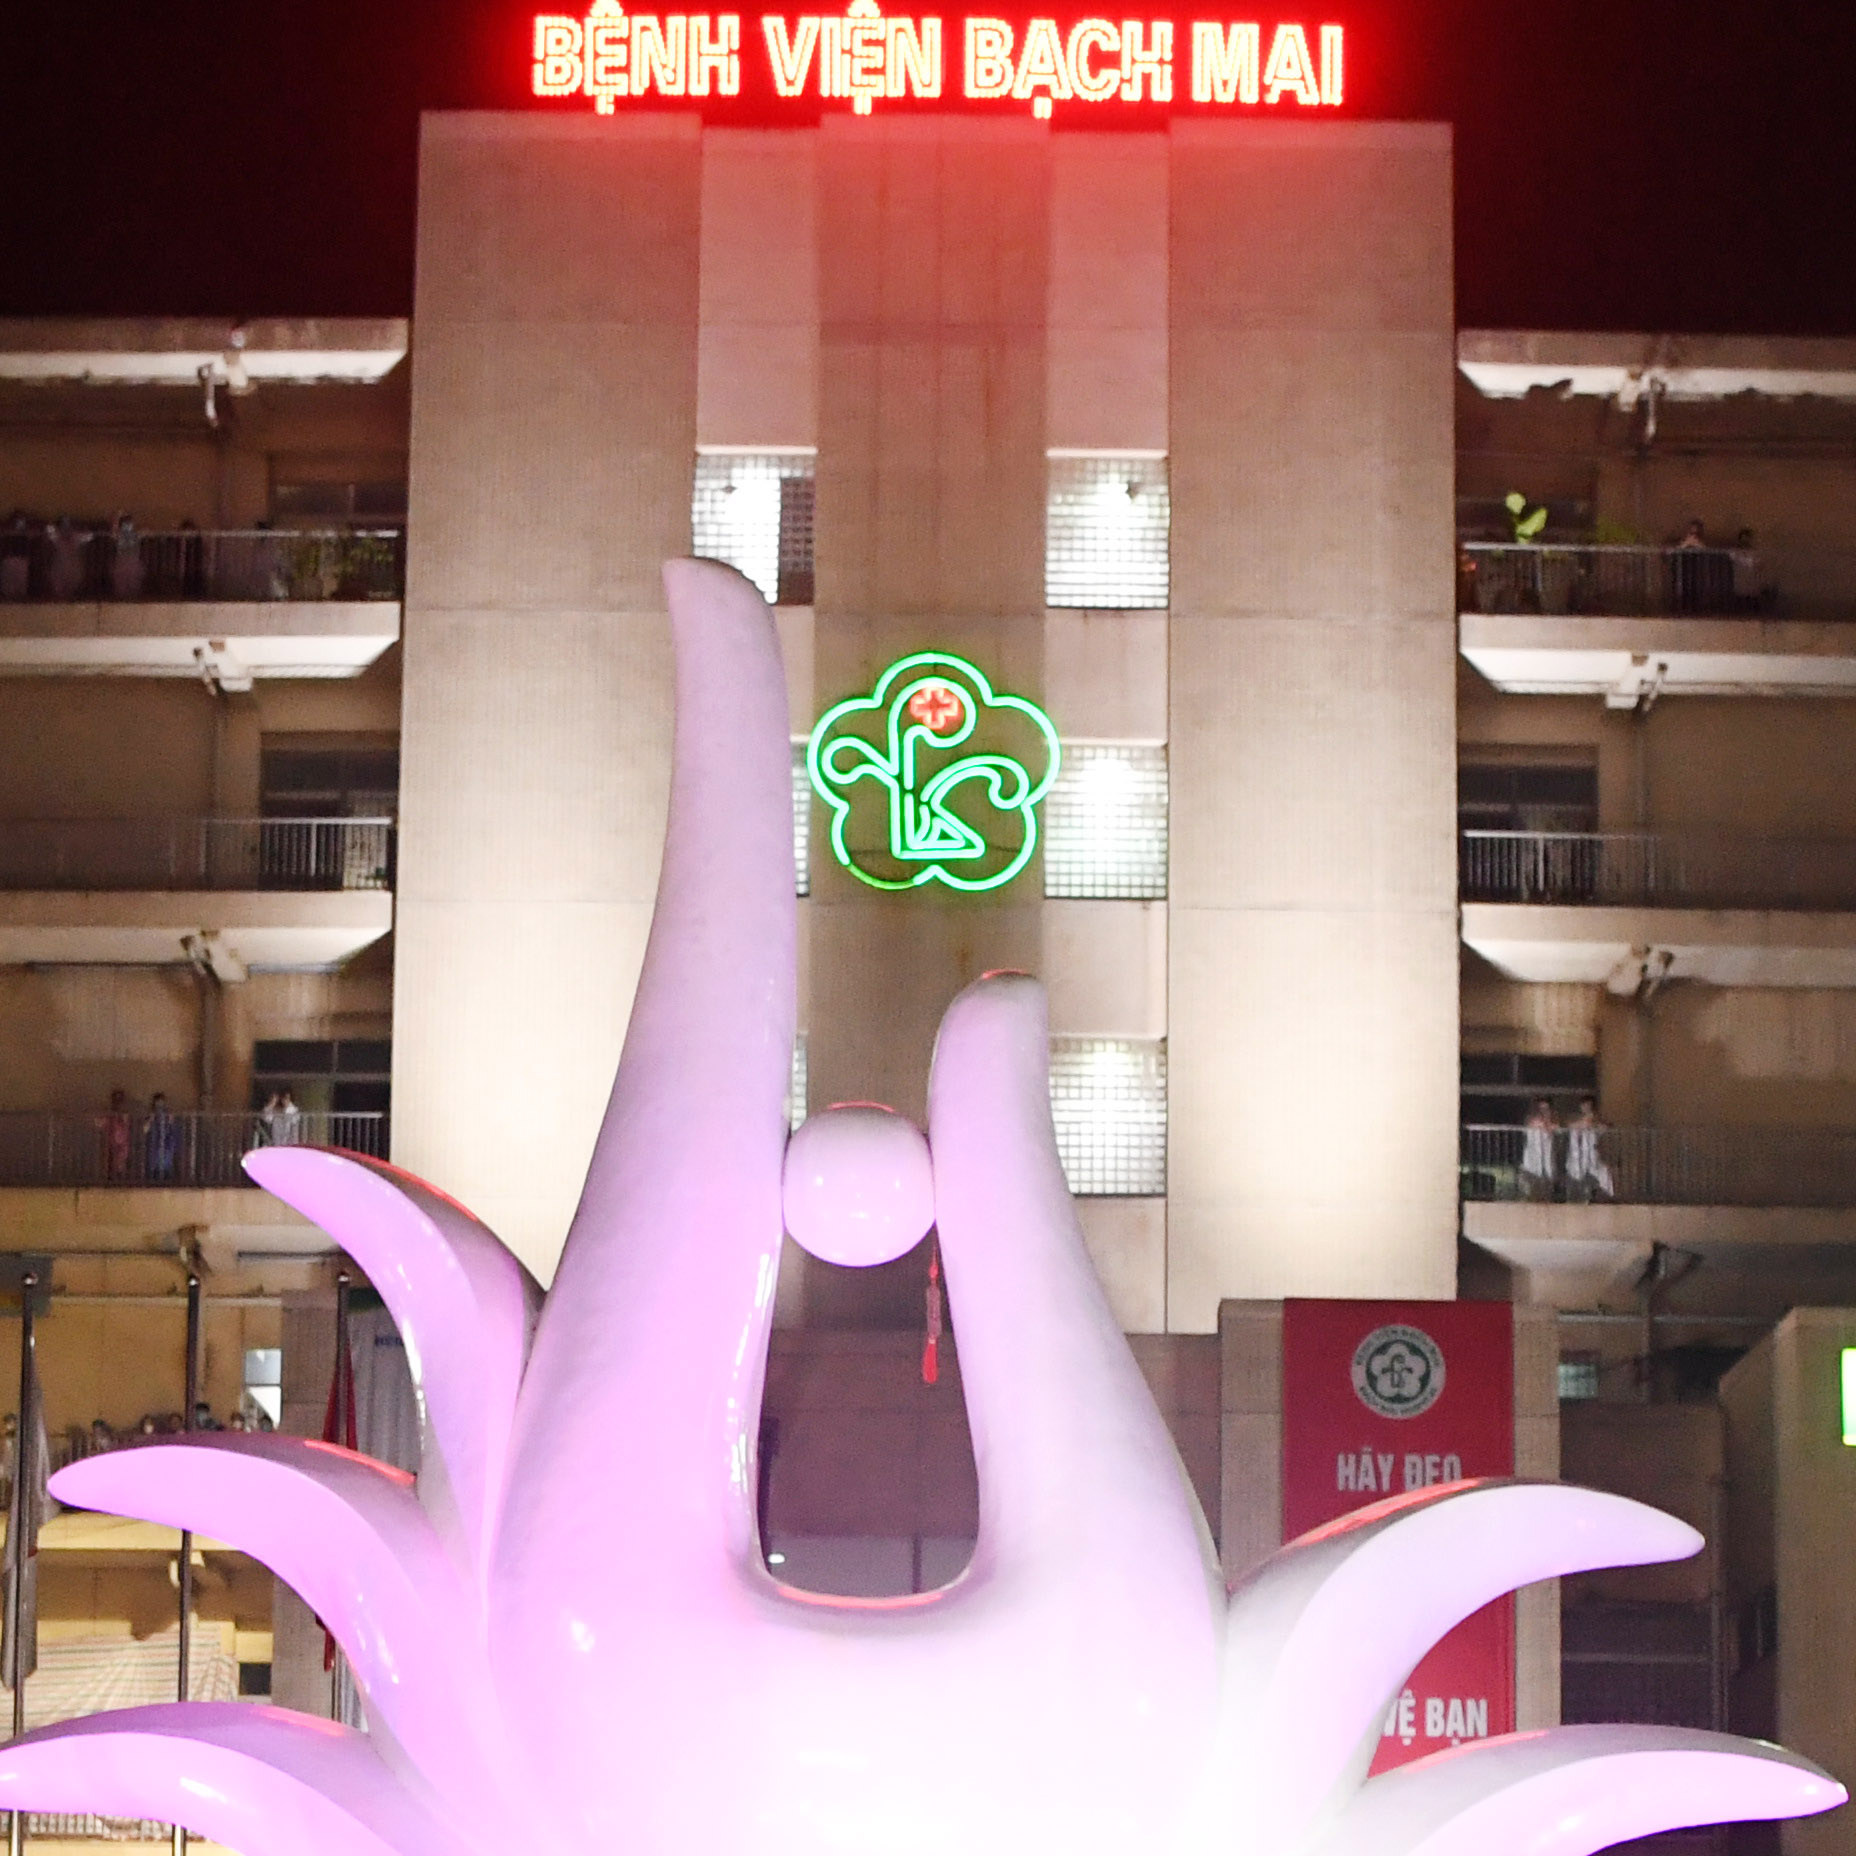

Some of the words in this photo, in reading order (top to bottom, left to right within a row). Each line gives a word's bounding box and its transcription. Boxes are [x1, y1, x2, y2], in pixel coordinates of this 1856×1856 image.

[532, 0, 741, 115] BỆNH
[763, 0, 943, 115] VIỆN
[964, 19, 1174, 119] BẠCH
[1192, 22, 1345, 106] MAI
[1337, 1446, 1394, 1492] HÃY
[1426, 1697, 1488, 1746] BẠN
